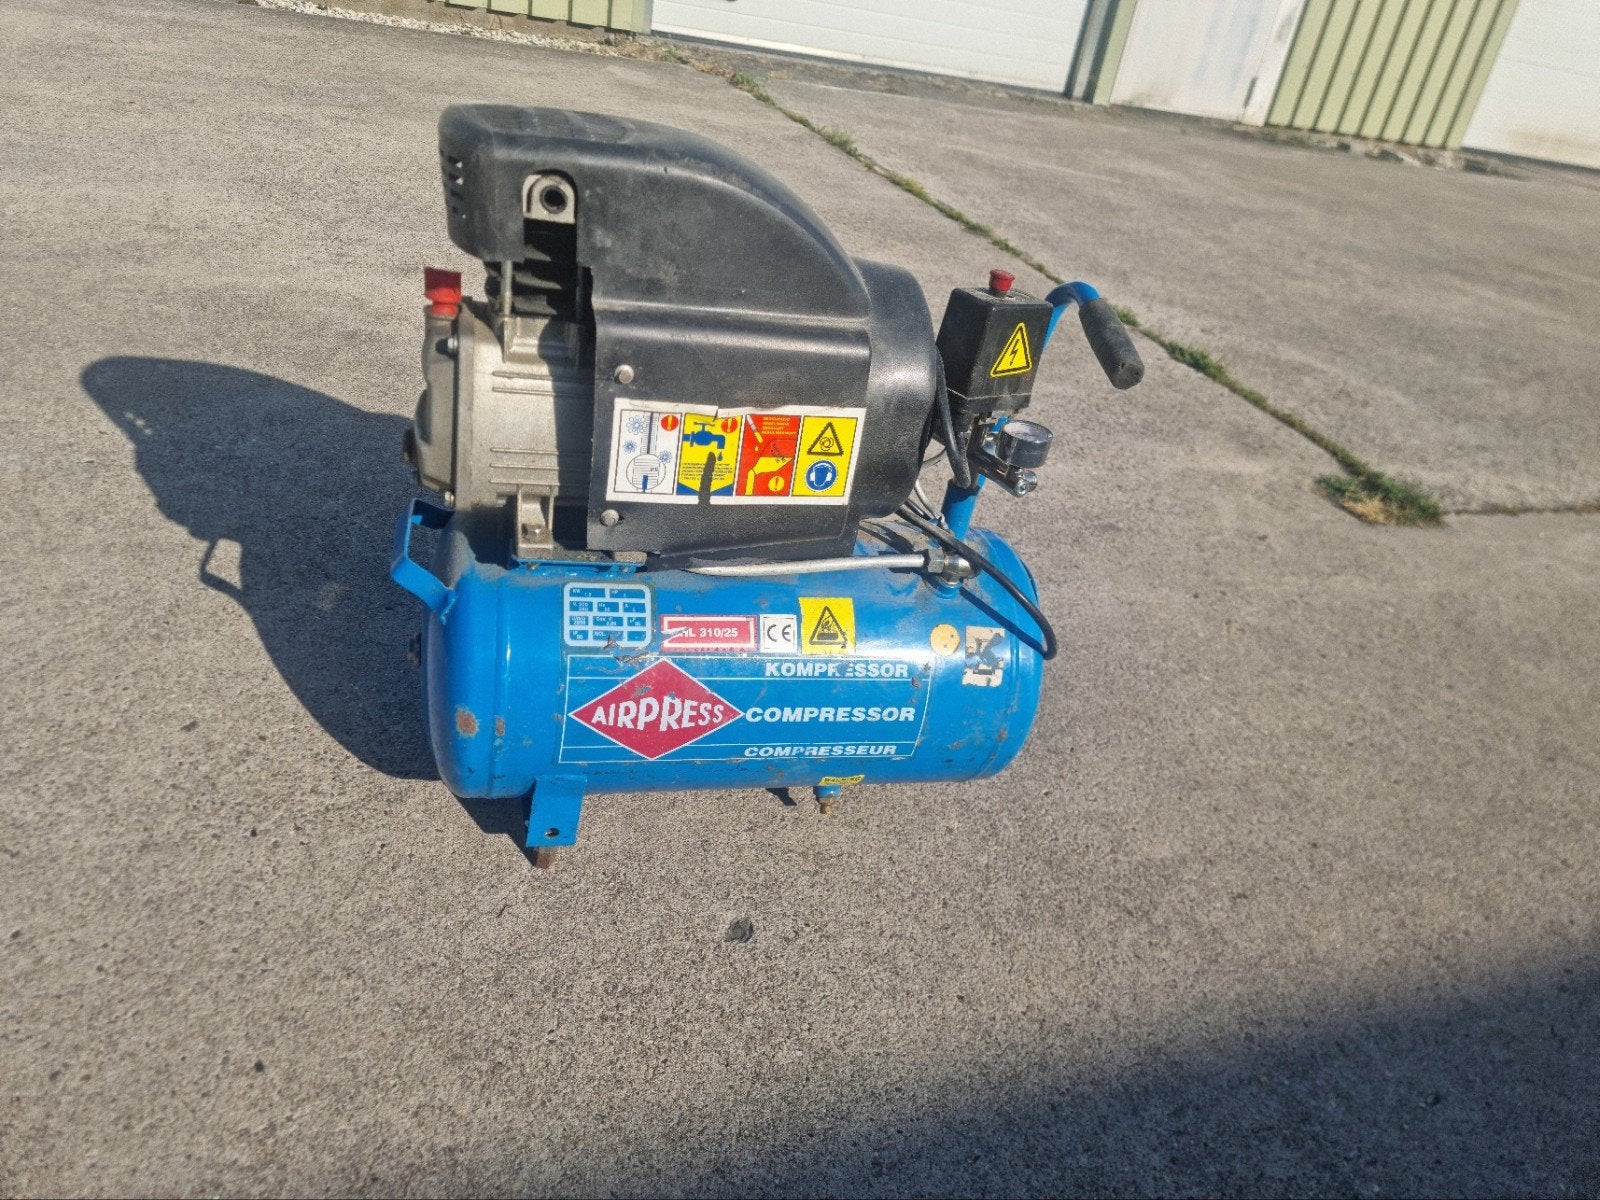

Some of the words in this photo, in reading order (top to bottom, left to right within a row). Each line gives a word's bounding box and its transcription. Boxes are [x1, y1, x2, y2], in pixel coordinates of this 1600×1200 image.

[700, 627, 738, 638] 310/25
[767, 624, 791, 642] CE
[591, 695, 724, 731] AIRPRESS
[745, 706, 916, 722] COMPRESSOR
[744, 745, 897, 757] COMPRESSEUR
